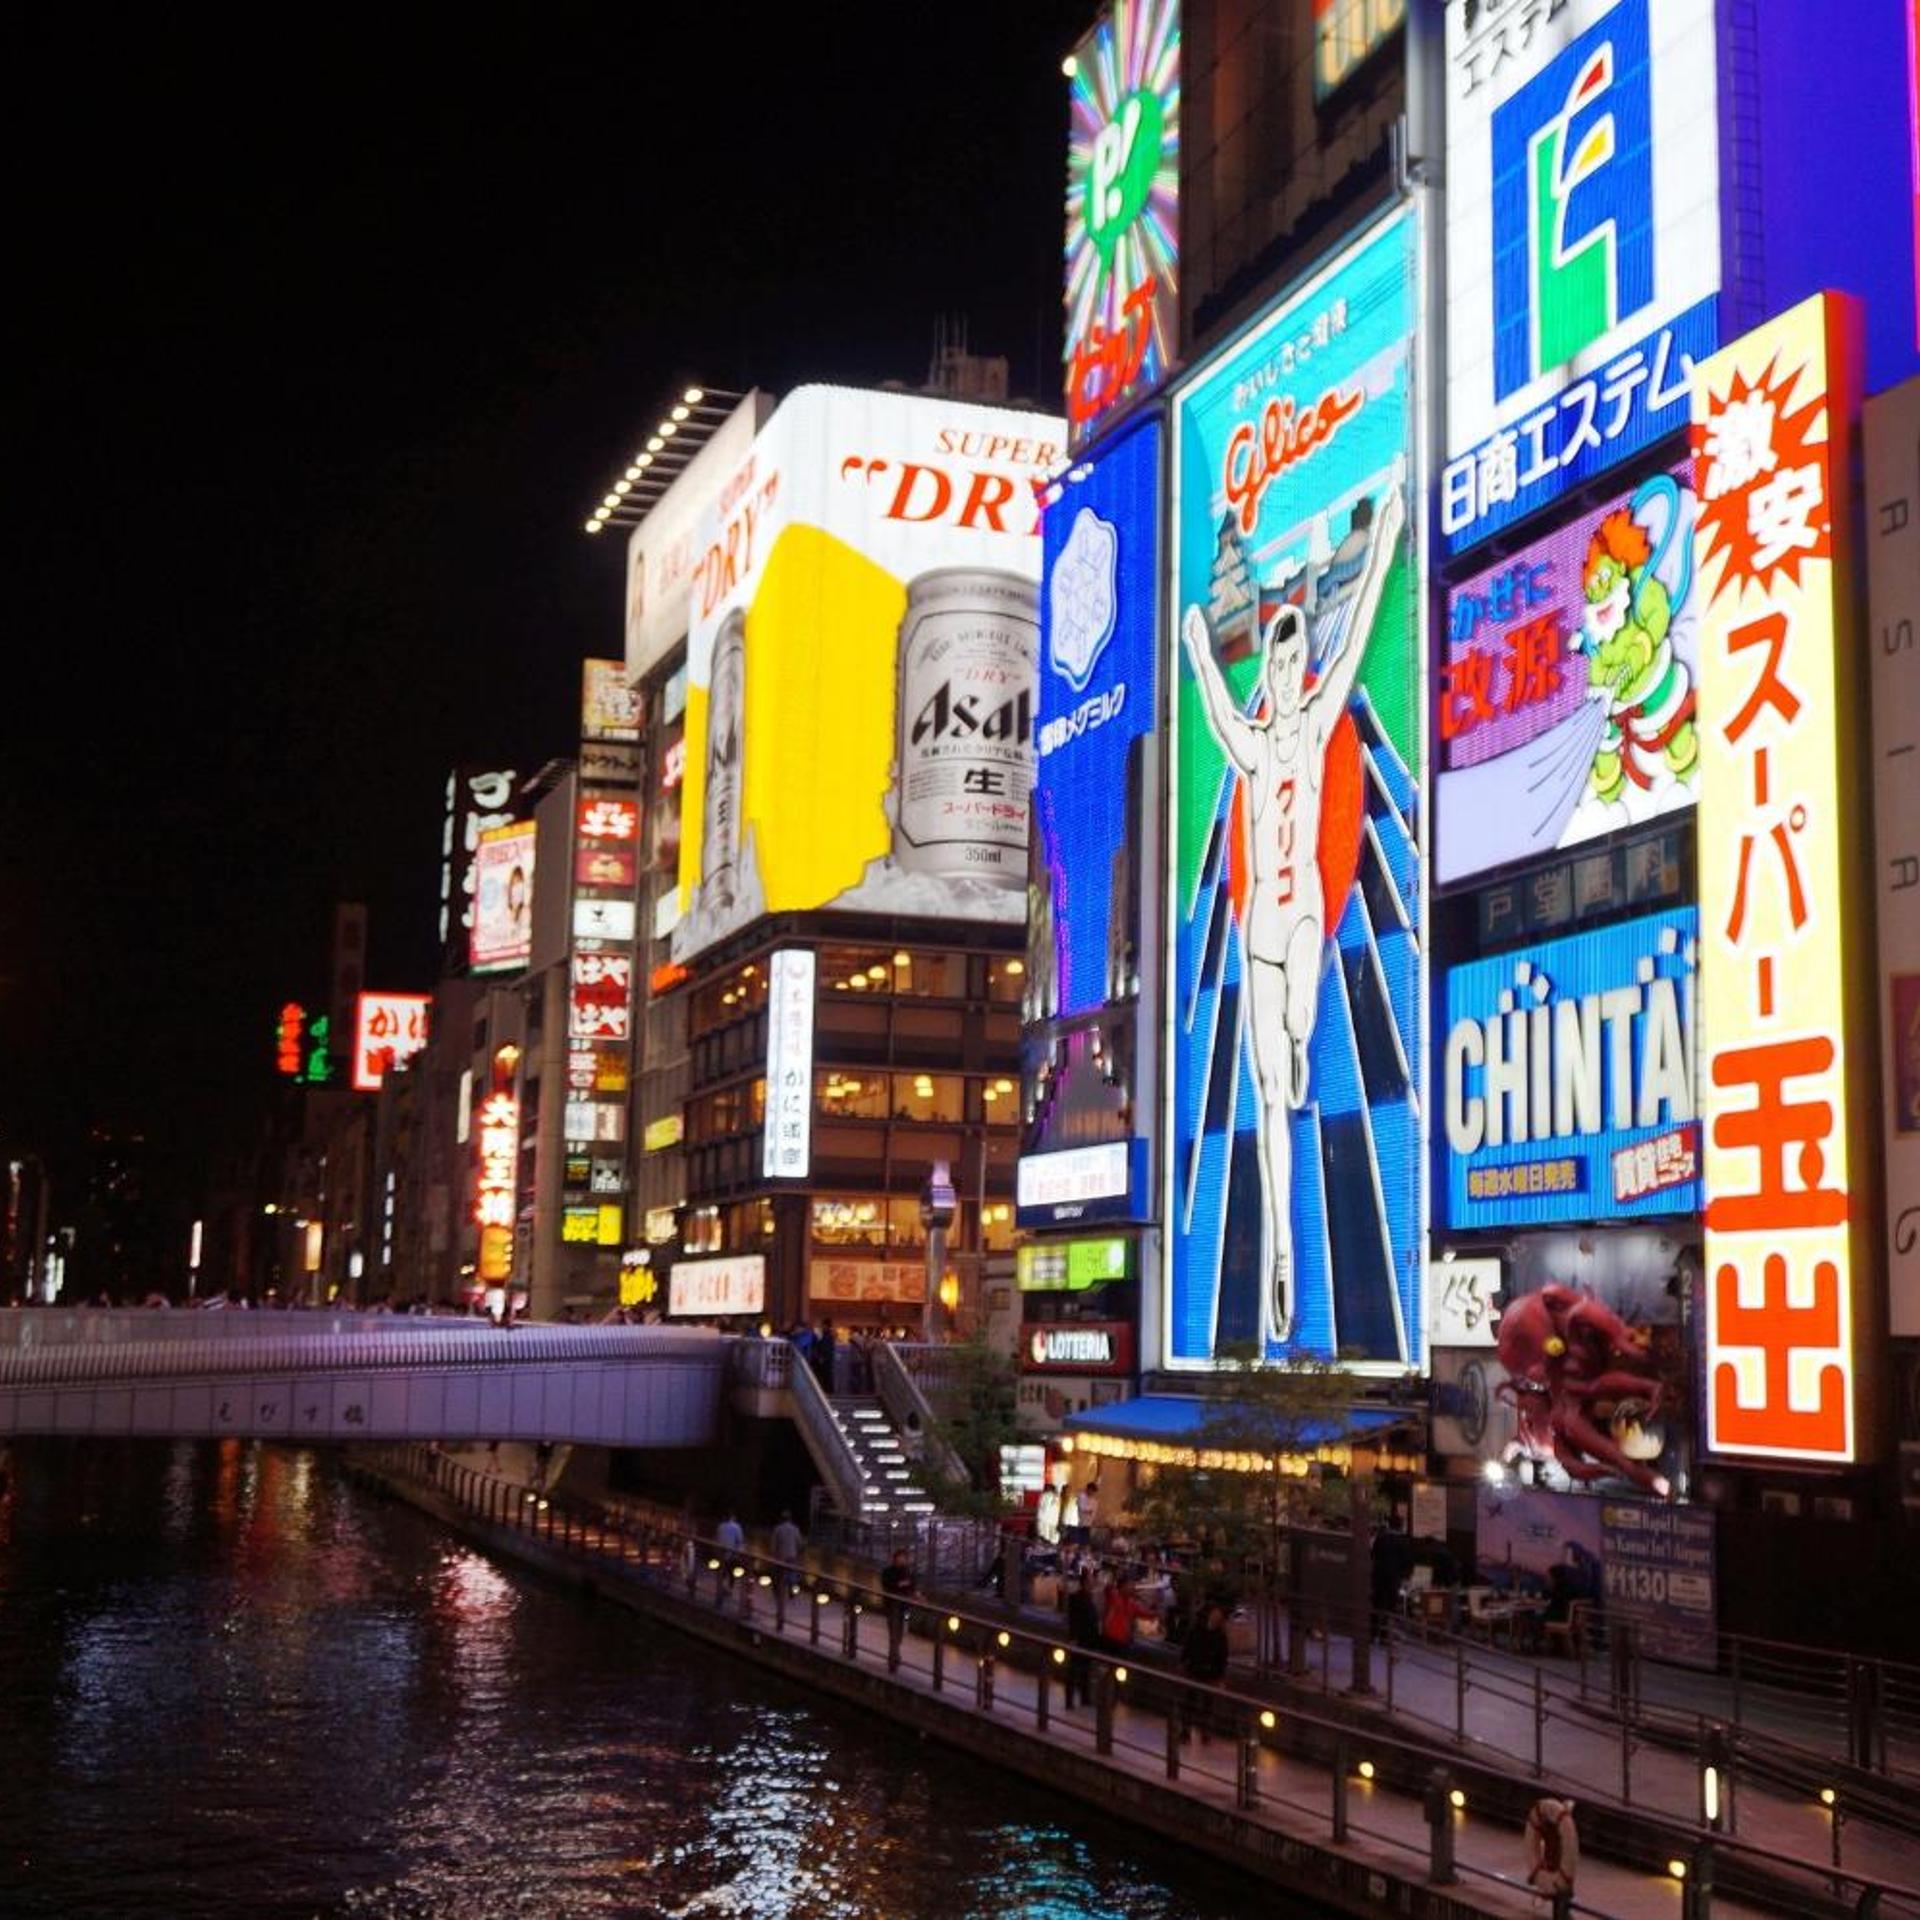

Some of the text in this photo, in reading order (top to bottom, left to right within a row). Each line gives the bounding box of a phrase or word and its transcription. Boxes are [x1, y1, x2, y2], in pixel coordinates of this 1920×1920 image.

[935, 428, 1060, 467] SUPER
[1226, 390, 1362, 534] Glico
[1441, 330, 1693, 535] 日商エステム
[1704, 389, 1823, 571] 激安
[1452, 559, 1554, 641] かぜに
[1440, 607, 1564, 740] 改源
[943, 802, 1026, 822] スーパードライ
[963, 767, 1005, 796] 生
[1706, 611, 1849, 1453] スーパー玉出
[1047, 1330, 1110, 1361] LOTTERIA
